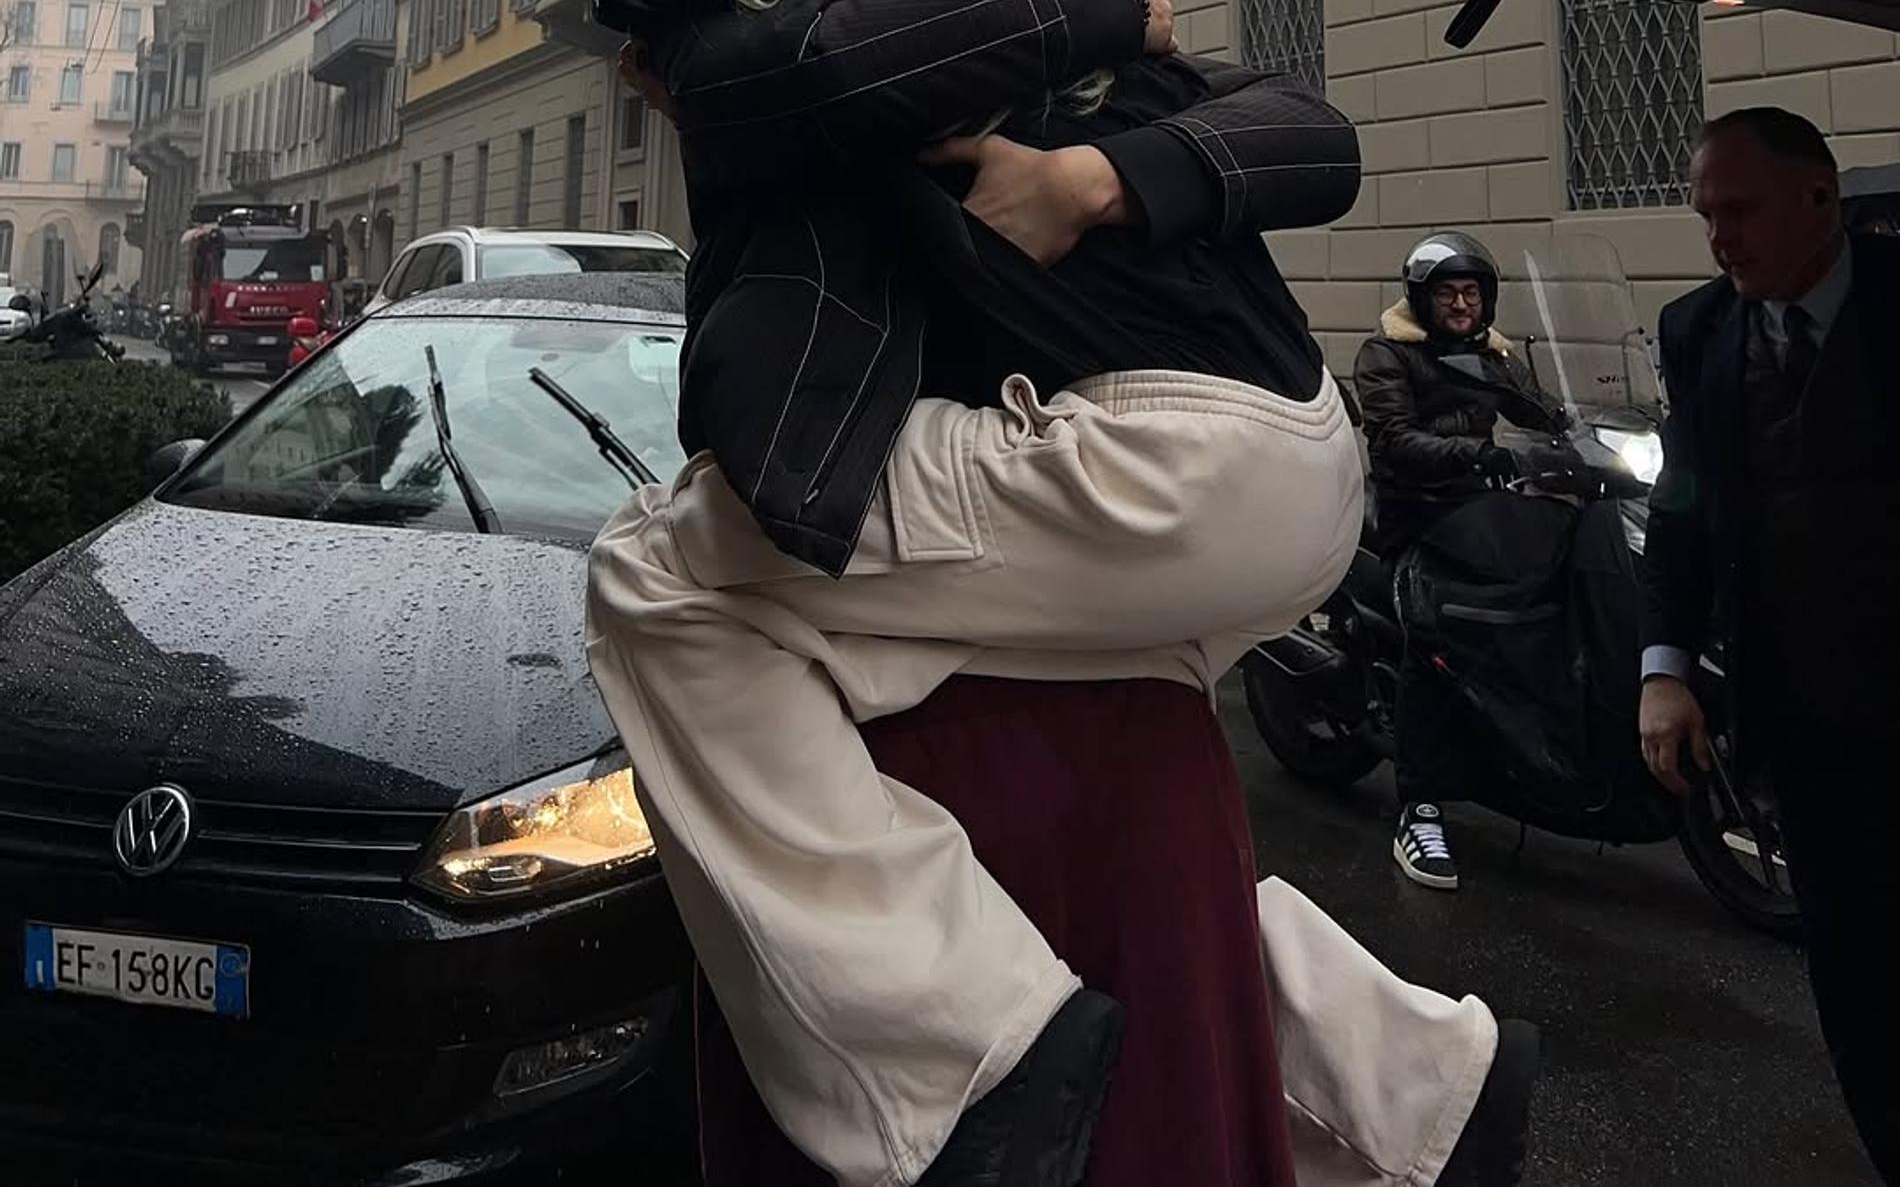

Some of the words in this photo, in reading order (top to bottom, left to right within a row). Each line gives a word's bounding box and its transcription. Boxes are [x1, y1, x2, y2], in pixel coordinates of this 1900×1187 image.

[249, 305, 290, 315] IVECO
[57, 942, 95, 986] EF
[111, 948, 214, 1000] 158KG
